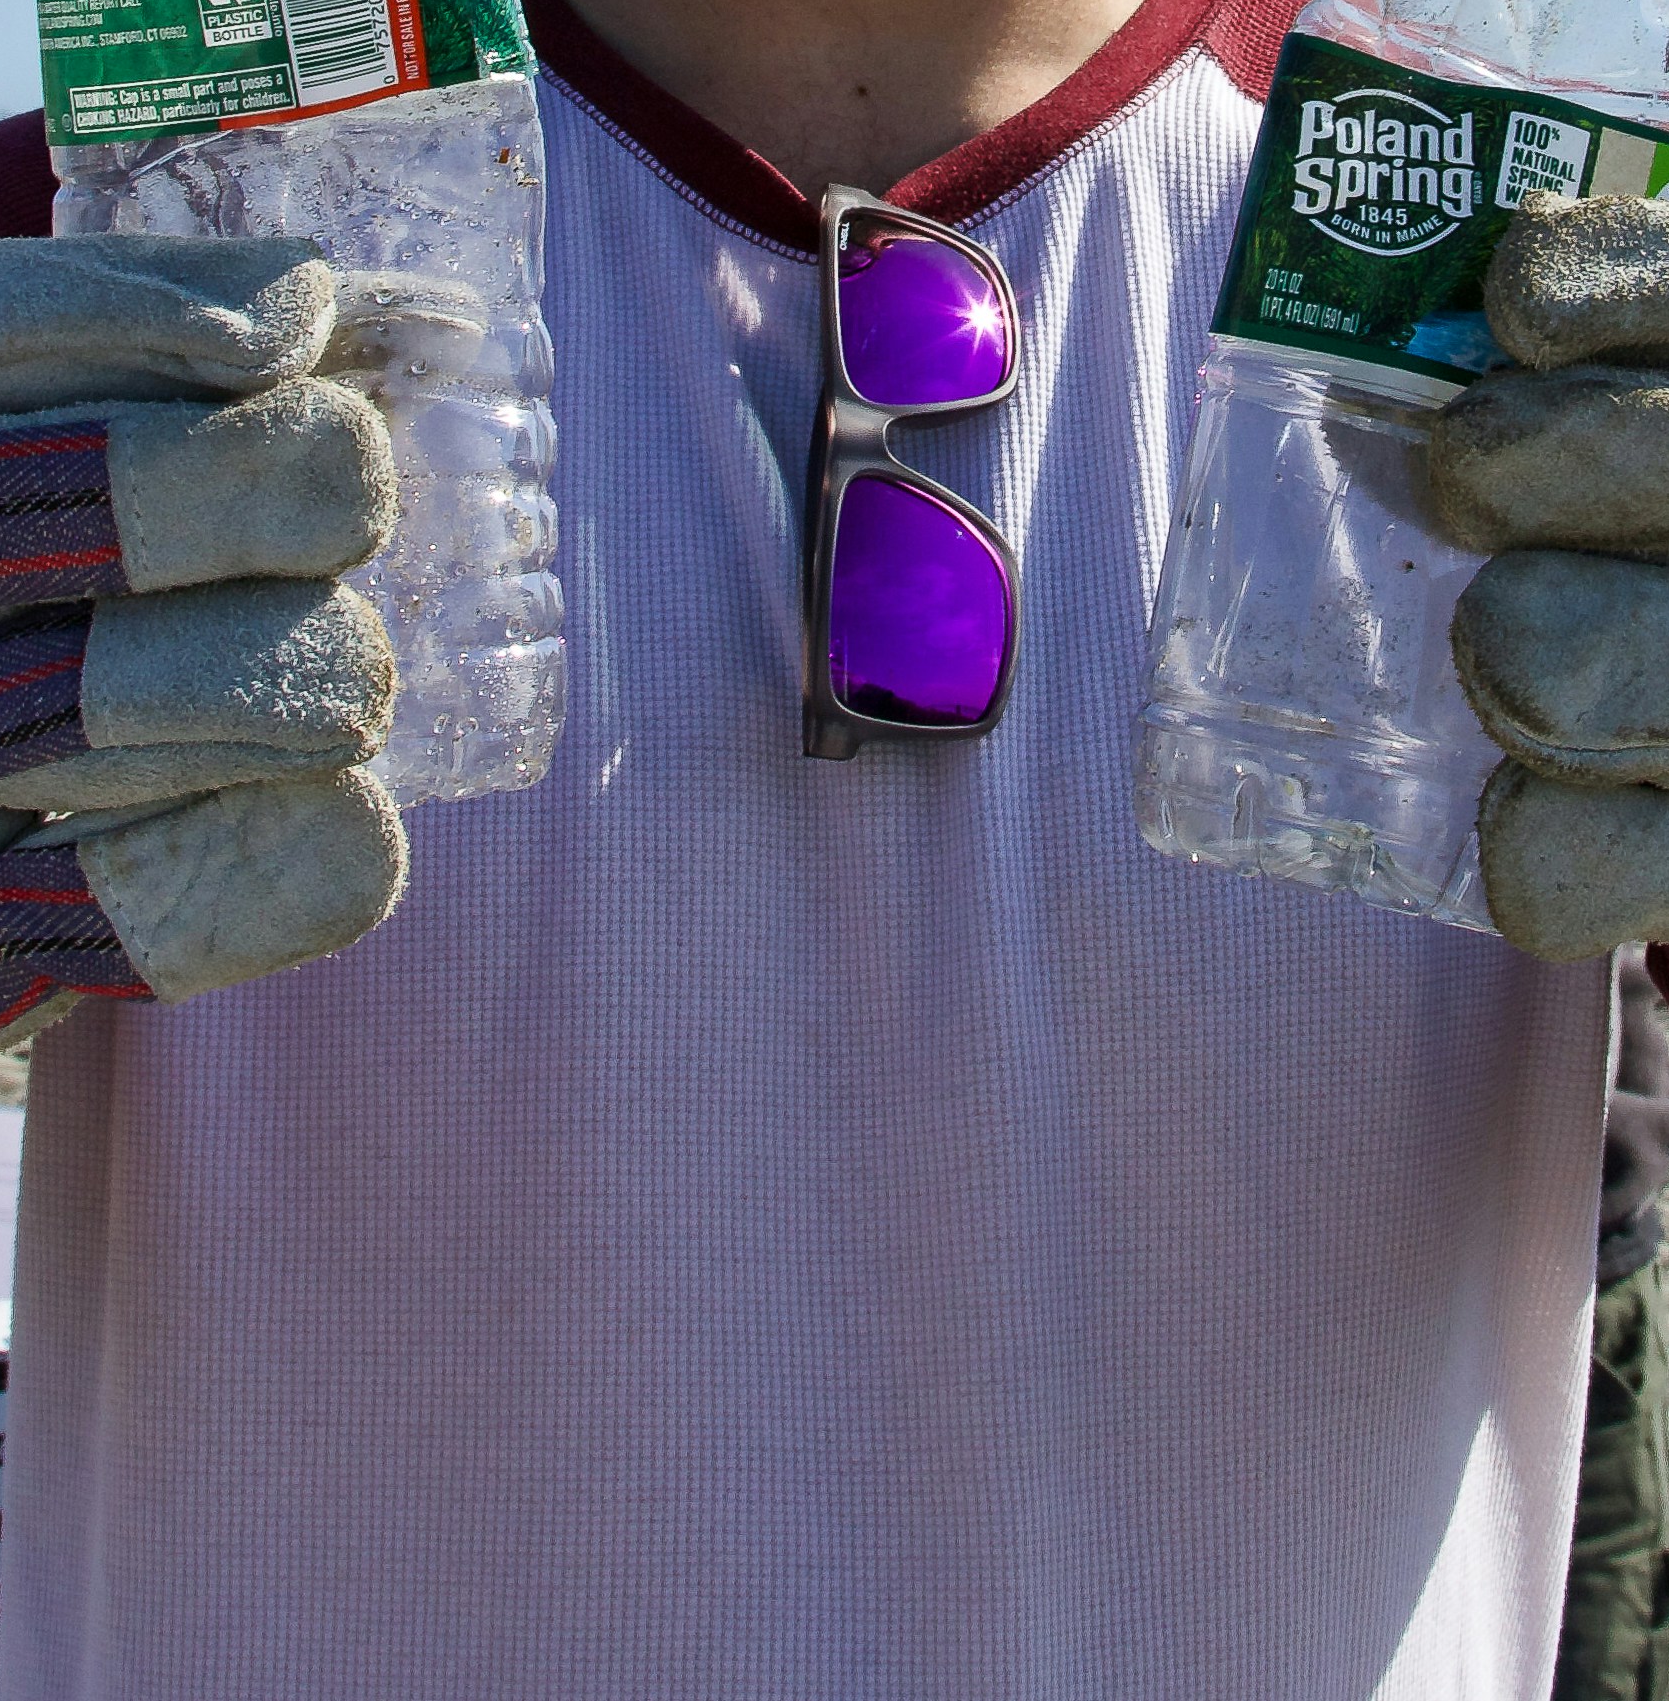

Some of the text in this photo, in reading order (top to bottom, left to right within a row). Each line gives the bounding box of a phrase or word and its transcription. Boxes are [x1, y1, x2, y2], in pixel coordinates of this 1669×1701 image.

[207, 9, 264, 27] PLASTIC
[397, 3, 412, 16] IN
[147, 28, 158, 42] CT
[212, 25, 265, 43] BOTTLE
[399, 15, 415, 40] SALE
[402, 40, 417, 59] FOR
[383, 75, 396, 85] 0
[404, 59, 420, 80] NOT
[73, 73, 283, 109] WARNING: Cap is a small part and poses a
[76, 109, 116, 127] CHOKING
[117, 106, 162, 123] HAZARD,
[163, 99, 221, 122] particularly
[222, 96, 239, 112] for
[242, 91, 292, 109] children.
[1296, 100, 1475, 166] Poland
[1513, 118, 1560, 150] 100%
[1510, 146, 1577, 183] NATURAL
[1291, 157, 1474, 219] Spring
[1508, 165, 1564, 196] SPRING
[1358, 204, 1408, 226] 1845
[1331, 213, 1444, 244] BORN IN MAINE
[1265, 268, 1303, 294] 20 FL OZ
[1285, 300, 1292, 321] 4
[1292, 301, 1303, 323] FL
